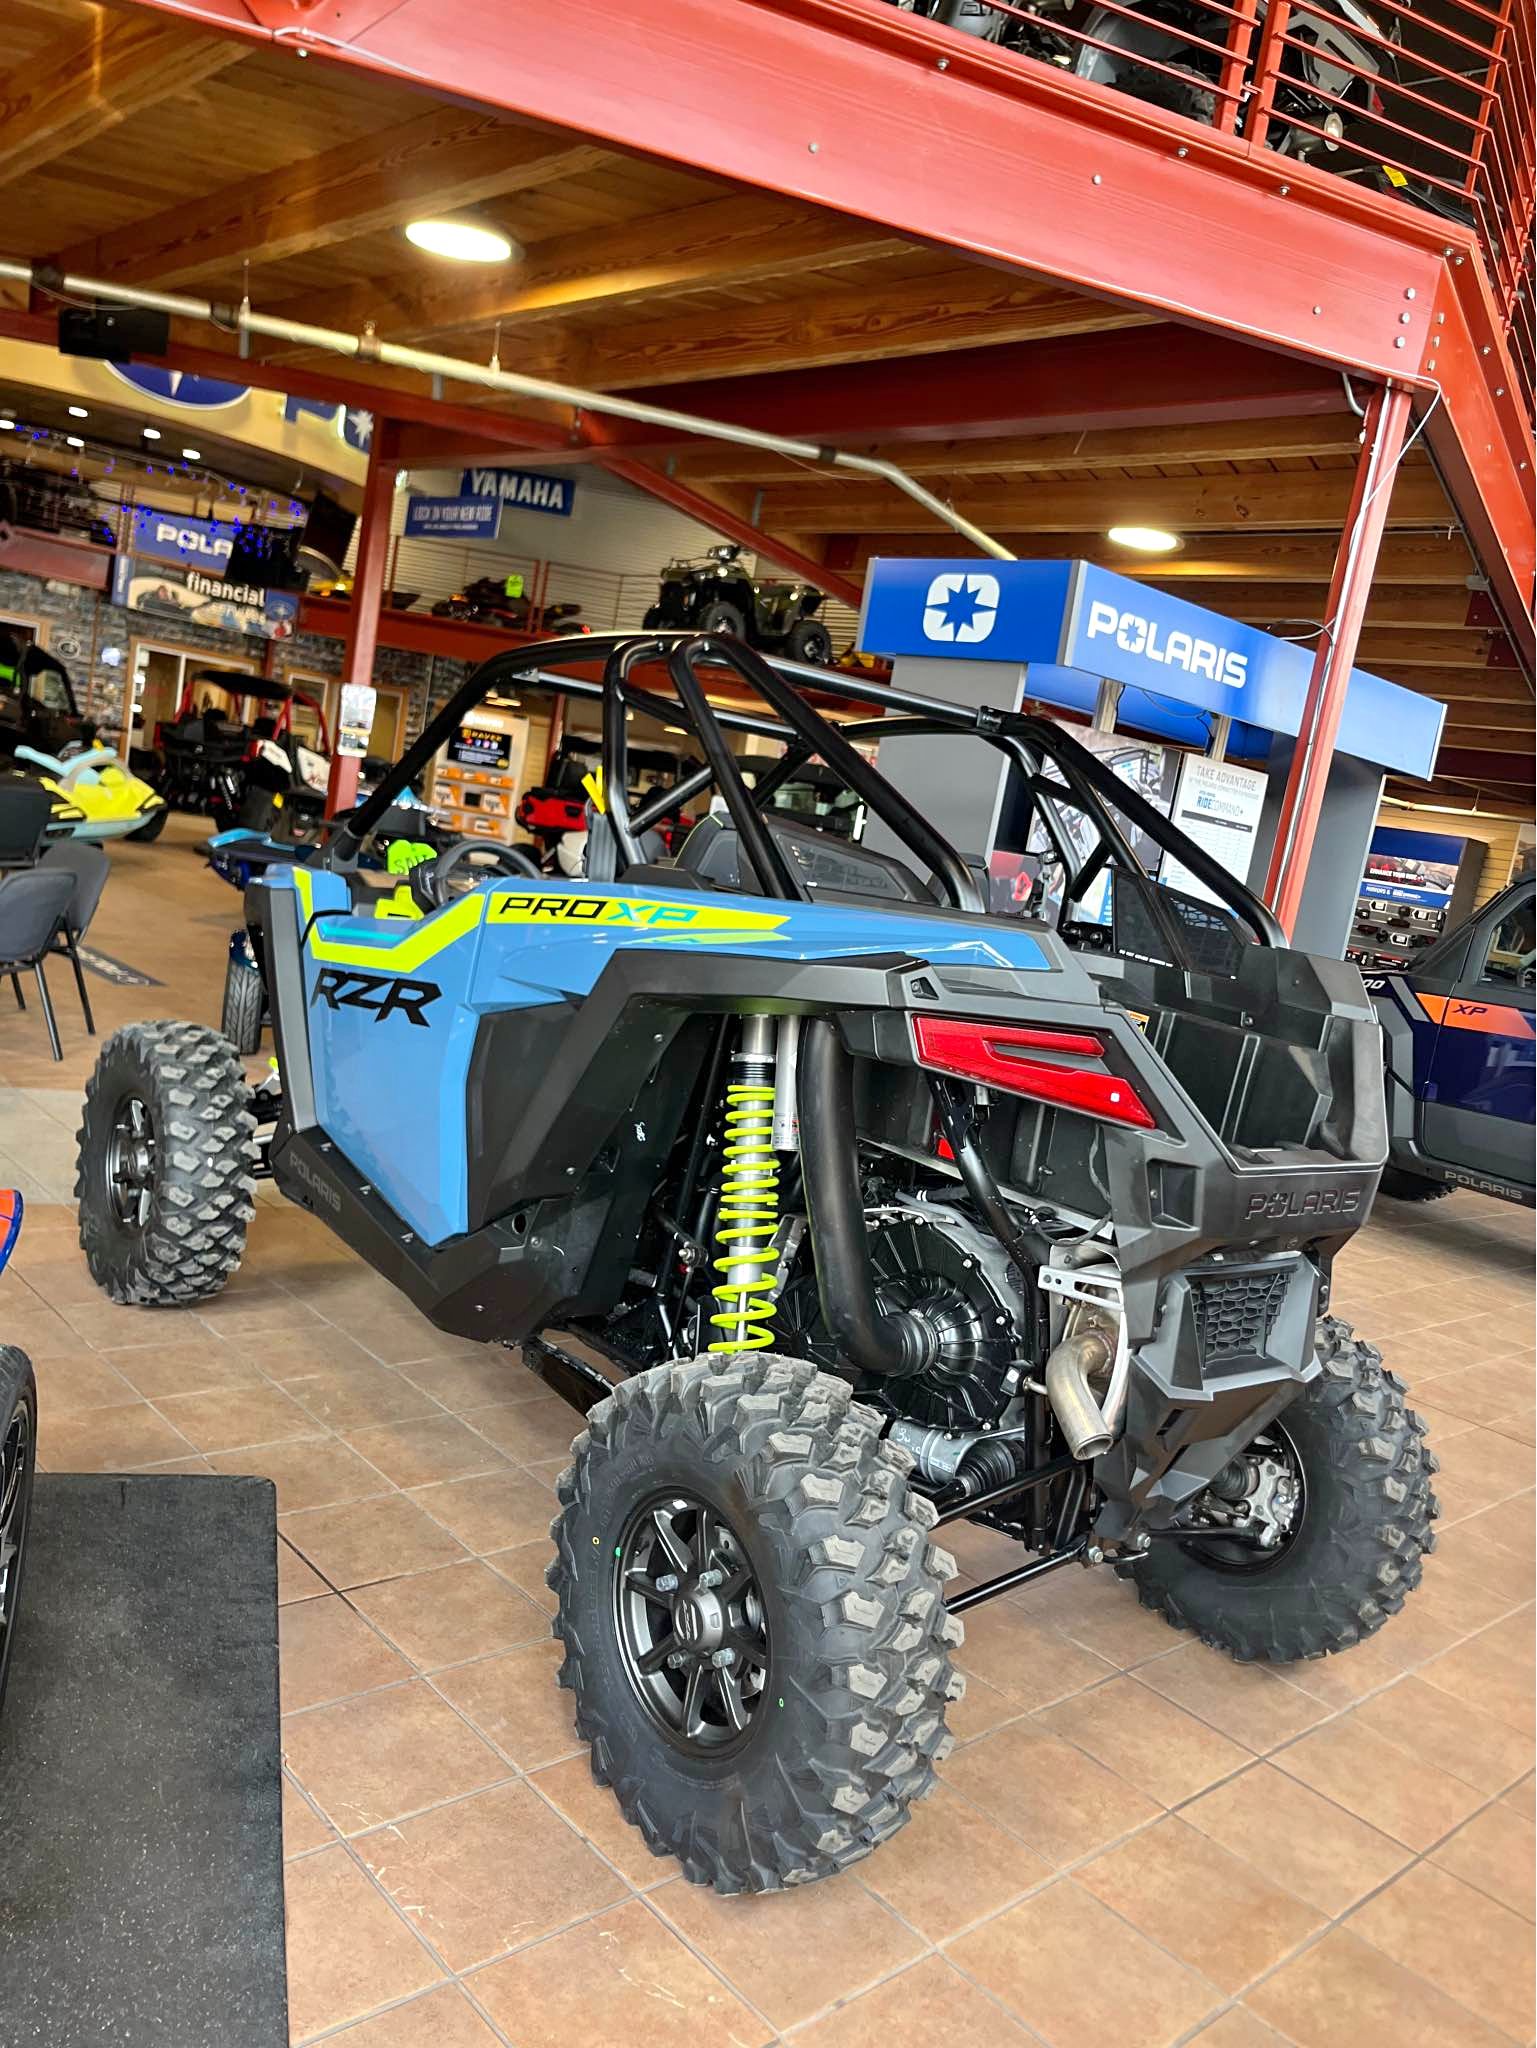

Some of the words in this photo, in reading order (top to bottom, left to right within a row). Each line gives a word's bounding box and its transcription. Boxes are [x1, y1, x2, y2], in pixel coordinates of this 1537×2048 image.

[471, 470, 564, 509] YAMAHA
[186, 570, 265, 607] financial
[1087, 600, 1248, 688] POLARIS
[1196, 765, 1215, 781] TAKE
[1216, 769, 1257, 792] ADVANTAGE
[310, 967, 442, 1028] RZR
[1452, 1004, 1488, 1017] XP
[289, 1151, 341, 1212] POLARIS
[1445, 1170, 1523, 1200] POLARIS
[1245, 1188, 1361, 1220] POLARIS
